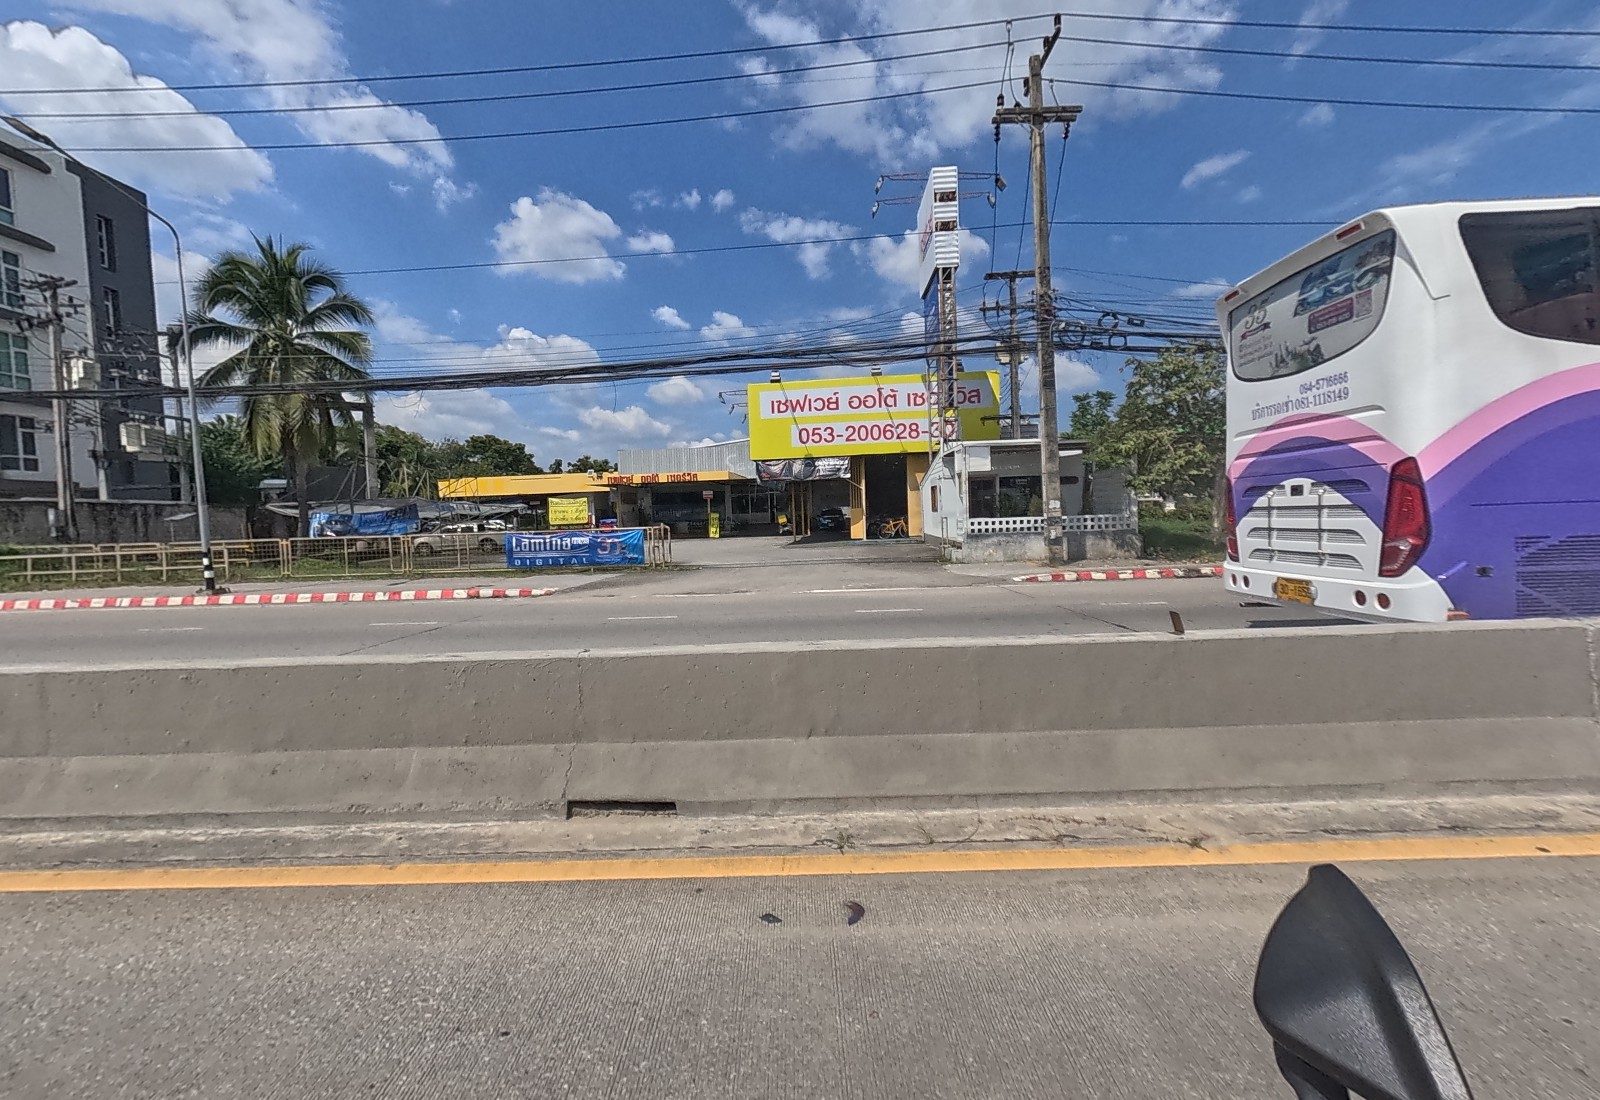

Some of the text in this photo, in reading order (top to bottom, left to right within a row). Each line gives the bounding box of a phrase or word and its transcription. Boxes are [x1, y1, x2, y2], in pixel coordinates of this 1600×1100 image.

[770, 386, 981, 414] เซฟเวย์ ออโต้ เซวิส
[512, 536, 571, 551] Lamina
[514, 557, 589, 566] DIGITAL
